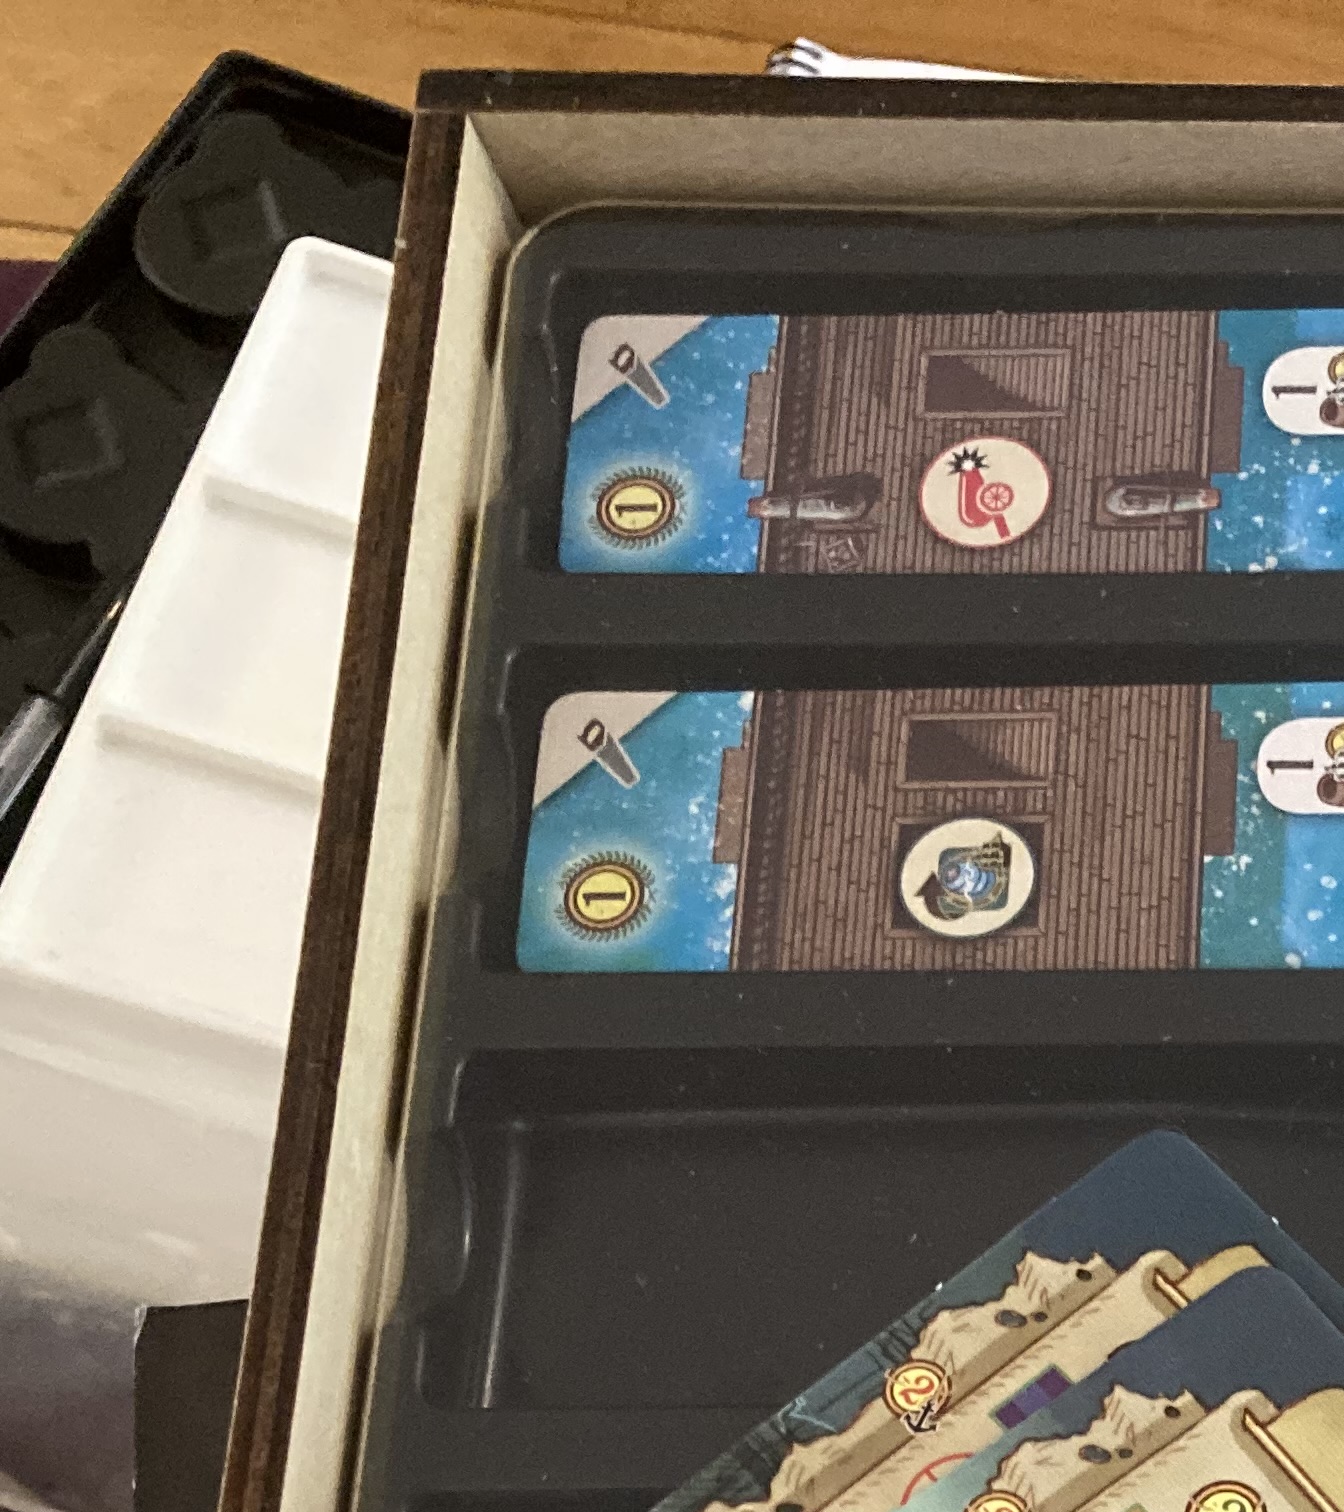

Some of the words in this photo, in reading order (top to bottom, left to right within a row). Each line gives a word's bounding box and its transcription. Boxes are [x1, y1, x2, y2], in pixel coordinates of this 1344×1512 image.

[1271, 385, 1317, 399] 1
[615, 503, 658, 517] 1
[1266, 760, 1313, 775] 1
[582, 892, 626, 907] 1
